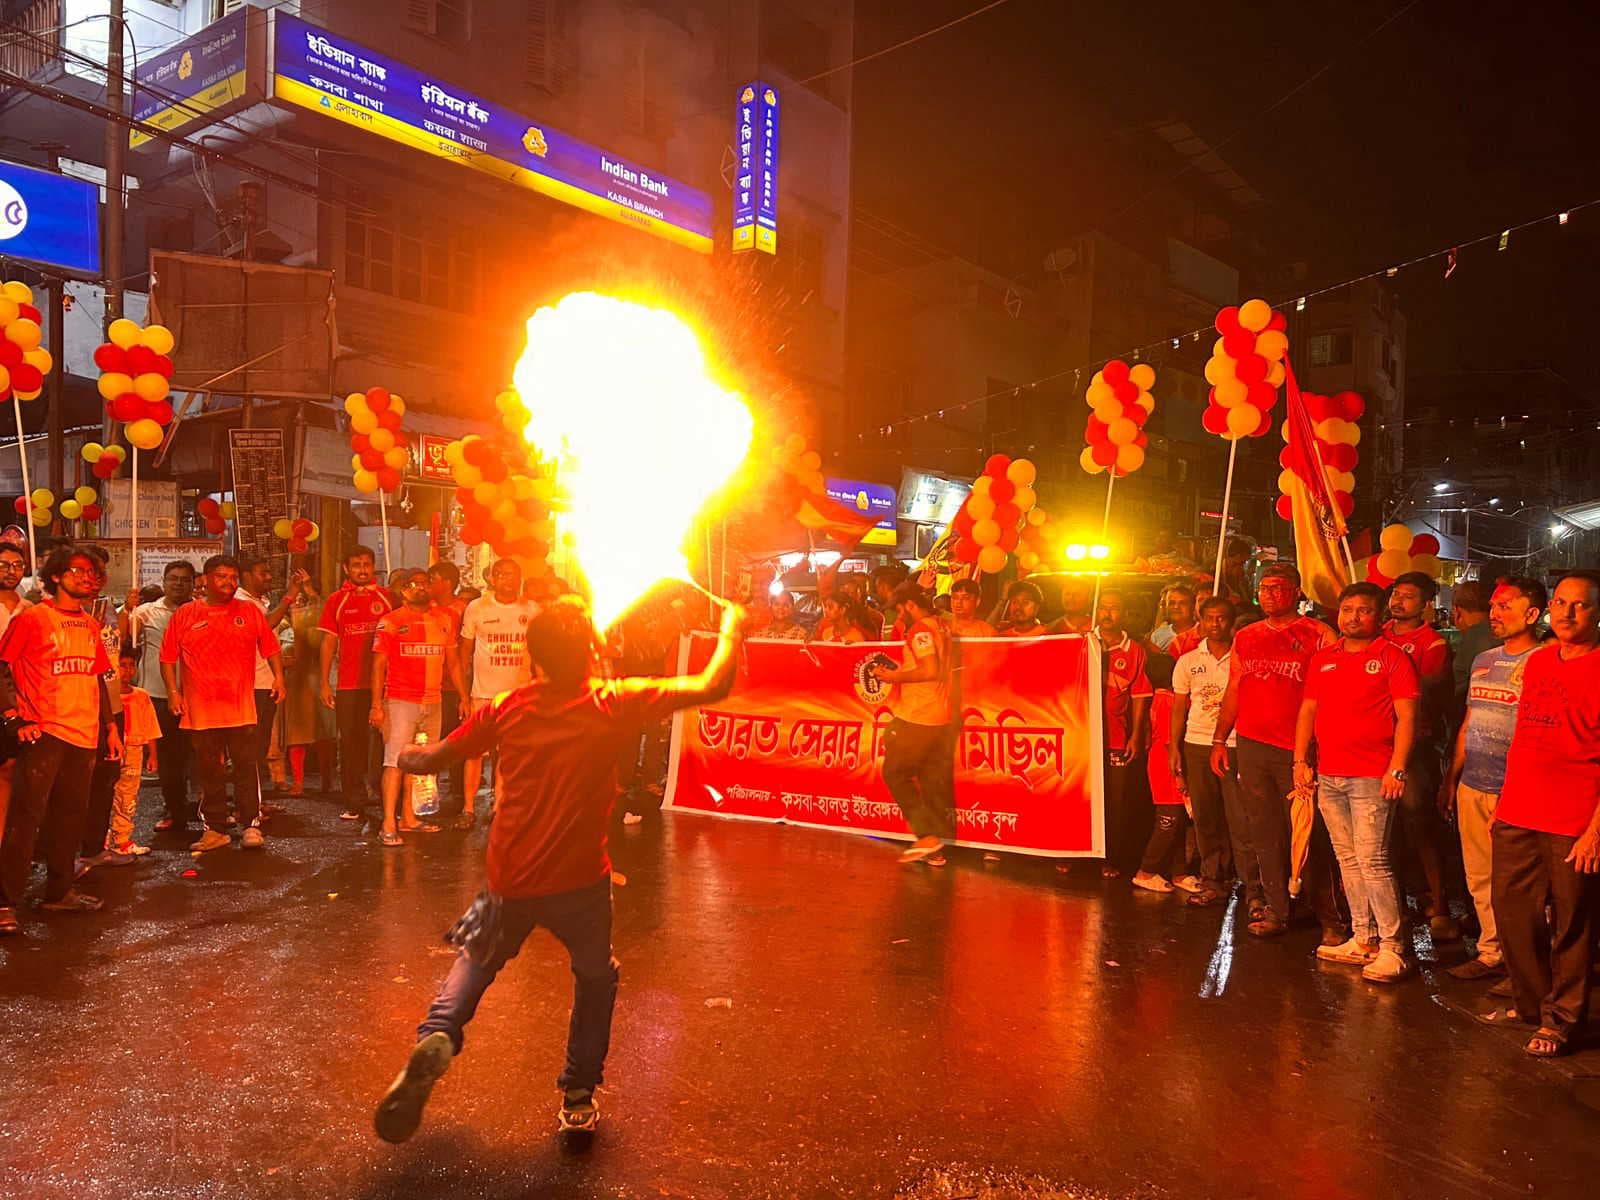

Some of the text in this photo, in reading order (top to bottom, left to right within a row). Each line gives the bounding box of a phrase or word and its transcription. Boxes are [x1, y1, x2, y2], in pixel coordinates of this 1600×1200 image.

[308, 75, 384, 112] কসবা শাখা
[421, 82, 465, 115] इंडियन
[423, 119, 456, 139] कसबा
[601, 156, 639, 185] Indian
[640, 173, 669, 196] Bank
[607, 190, 633, 208] KASBA
[633, 200, 664, 219] BRANCH
[697, 708, 783, 761] ভারত
[788, 718, 865, 770] সেরার
[959, 707, 1065, 791] মিছিল
